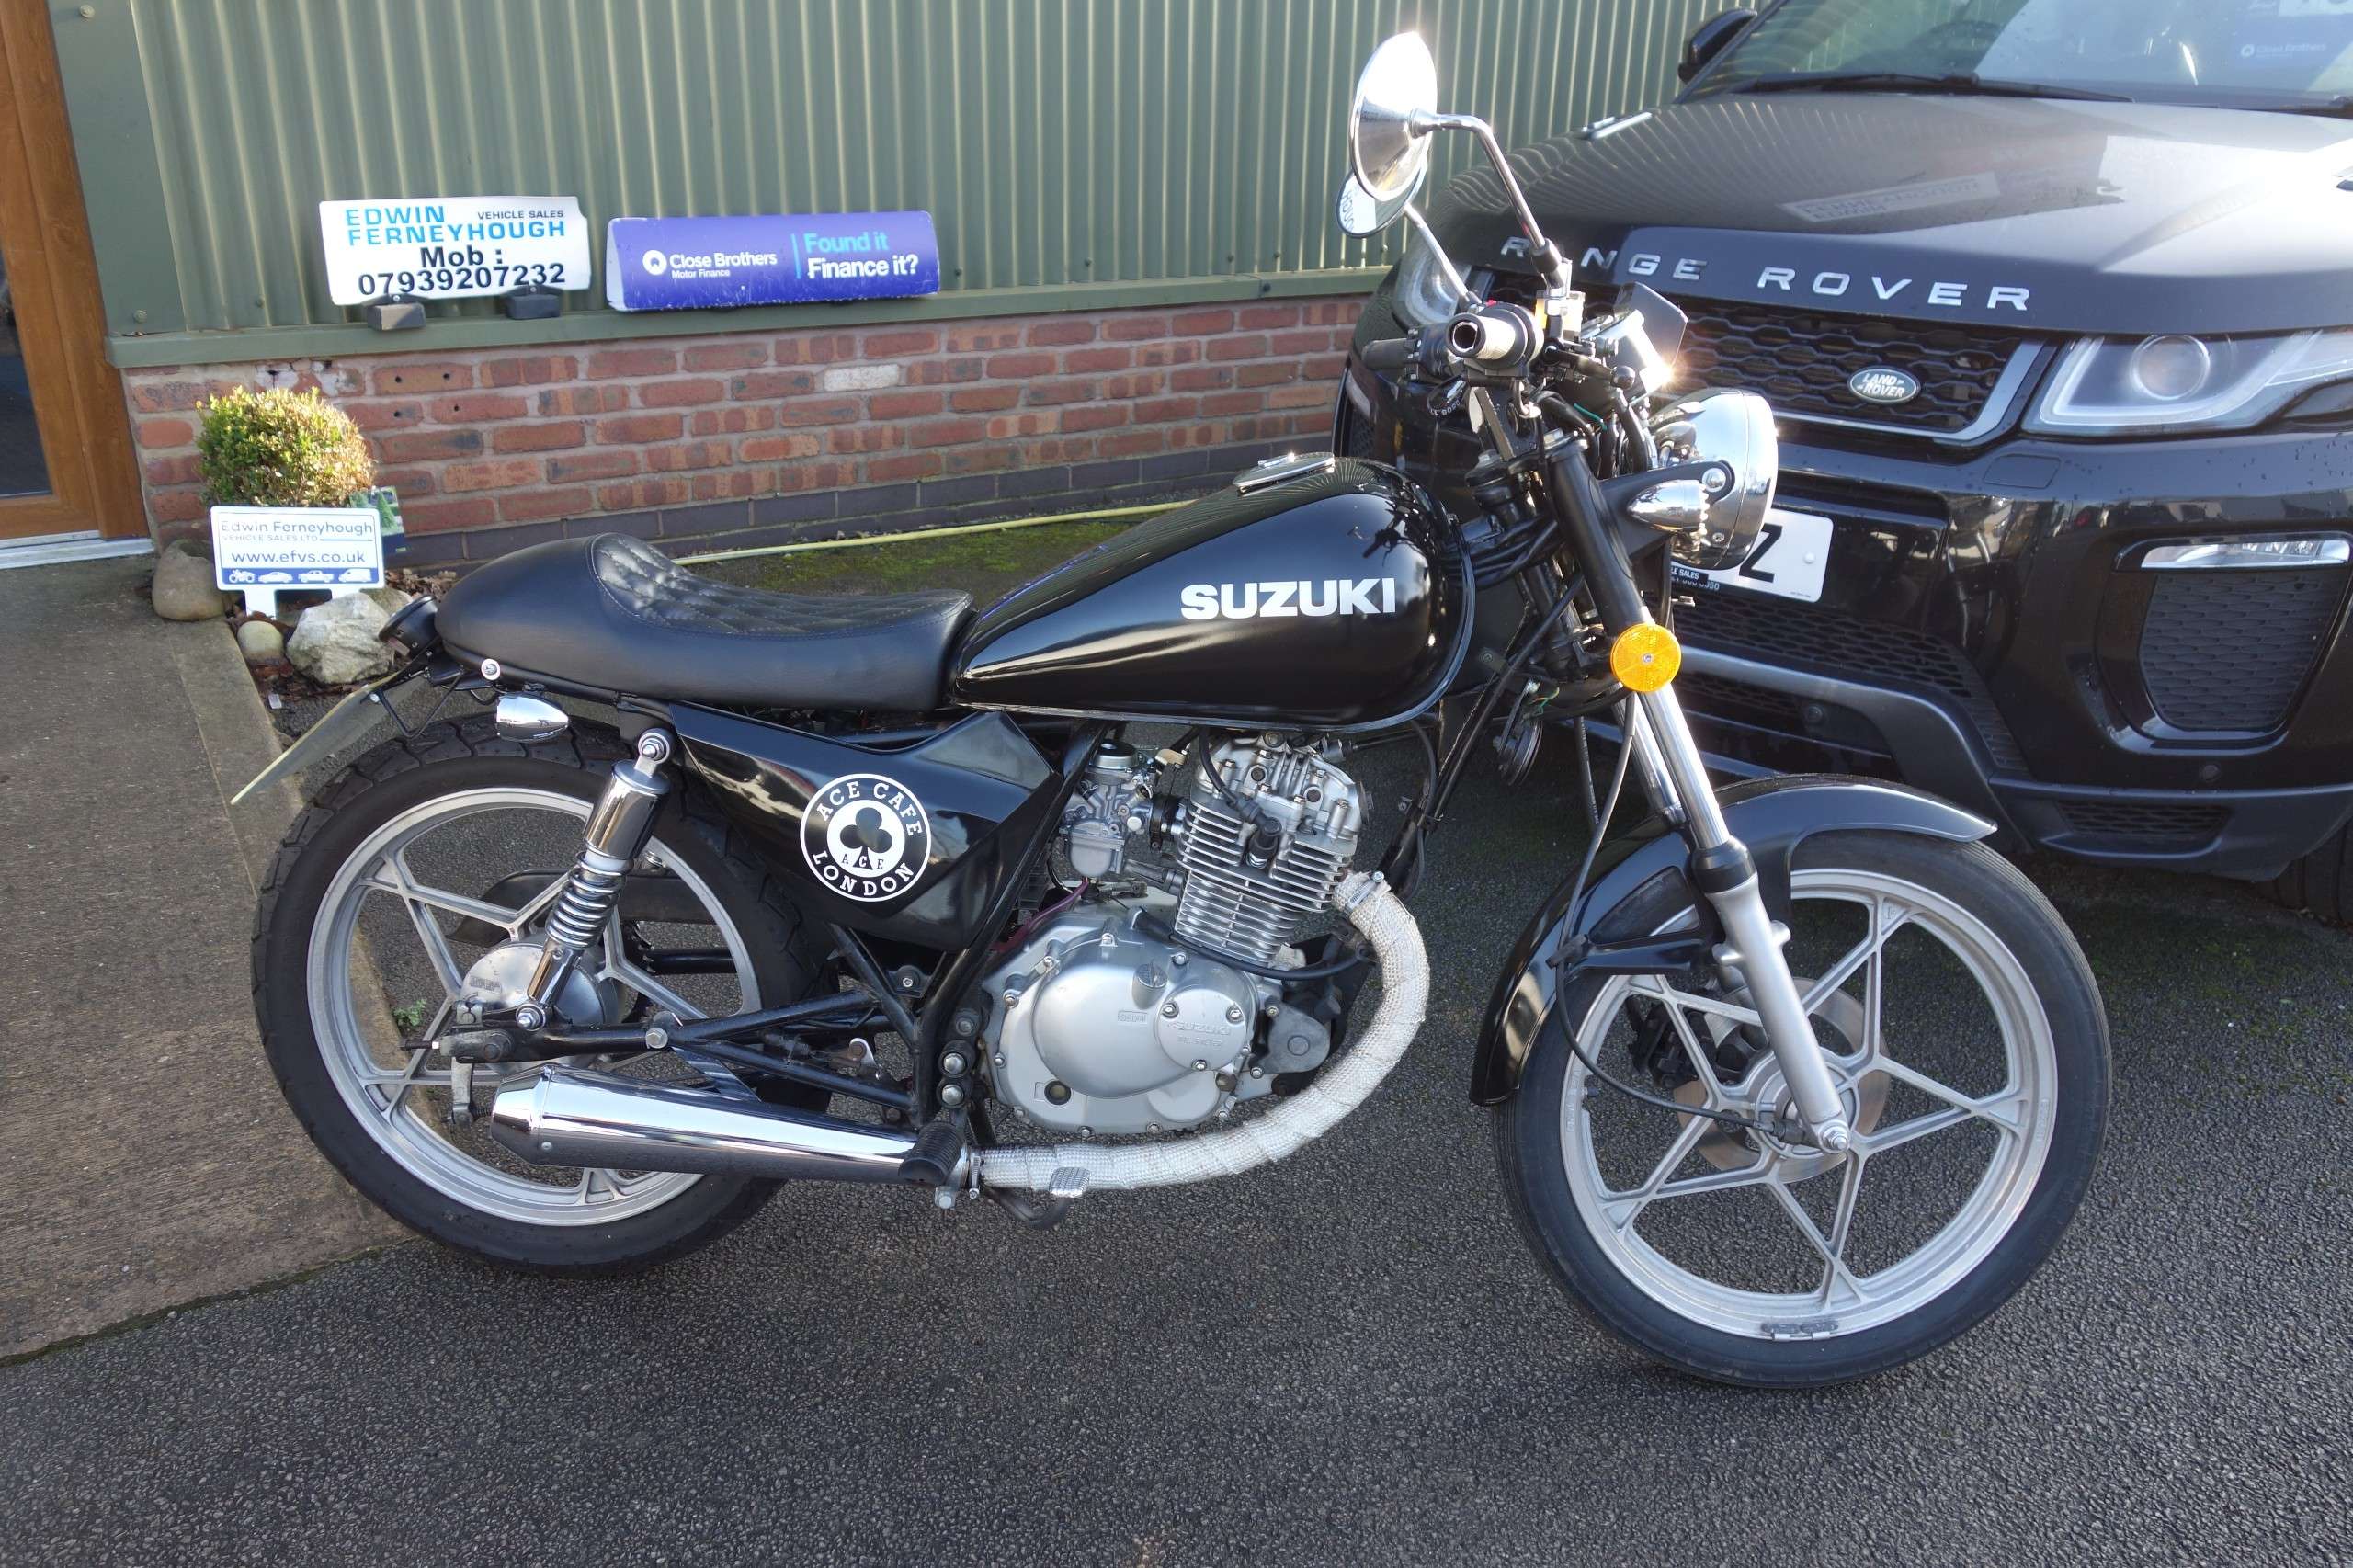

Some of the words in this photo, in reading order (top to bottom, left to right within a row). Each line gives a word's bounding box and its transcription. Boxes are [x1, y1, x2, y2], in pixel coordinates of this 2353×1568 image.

[346, 205, 445, 226] EDWIN
[477, 210, 525, 220] VEHICLE
[529, 210, 564, 219] SALES
[348, 220, 565, 246] FERNEYHOUGH
[803, 232, 871, 254] Found
[872, 232, 889, 251] it
[420, 244, 484, 268] Mob
[669, 254, 712, 269] Close
[713, 251, 778, 267] Brothers
[807, 256, 890, 279] Finance
[892, 253, 919, 276] it?
[358, 262, 565, 296] 07939207232
[672, 269, 697, 279] Motor
[698, 267, 730, 278] Finance
[1500, 235, 1708, 281] RNGE
[1756, 267, 2031, 311] ROVER
[221, 520, 268, 533] Edwin
[273, 521, 373, 536] Ferneyhough
[222, 534, 264, 542] VEHICLE
[267, 534, 298, 542] SALES
[231, 550, 367, 563] www.efvs.co.uk
[1679, 569, 1699, 580] SALES
[1180, 577, 1396, 620] SUZUKI
[816, 780, 860, 822] ACE
[873, 782, 923, 836] CAFE
[813, 850, 914, 896] LONDON
